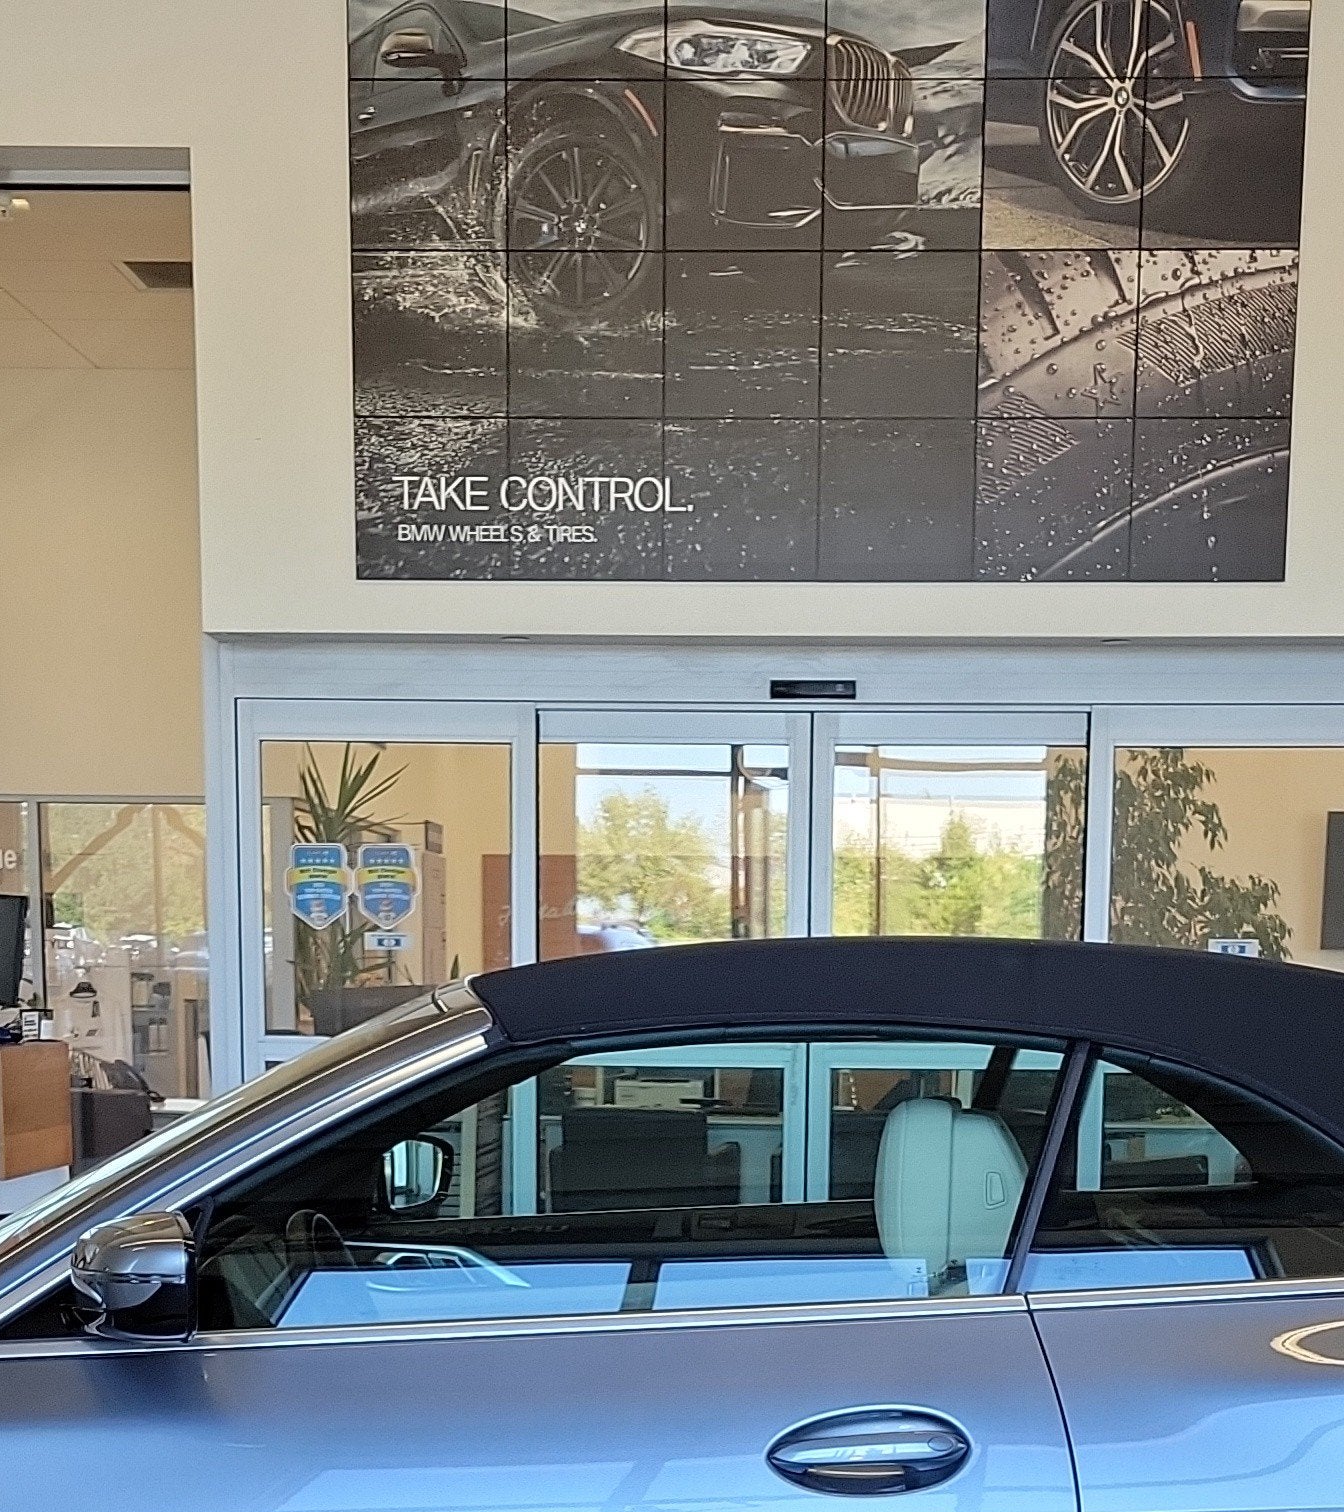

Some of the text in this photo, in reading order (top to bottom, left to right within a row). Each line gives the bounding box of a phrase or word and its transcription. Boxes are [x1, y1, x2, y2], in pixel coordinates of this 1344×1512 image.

[392, 475, 694, 513] TAKE CONTROL.
[397, 524, 447, 542] BMW
[448, 525, 524, 542] WHEELS
[527, 525, 542, 542] &
